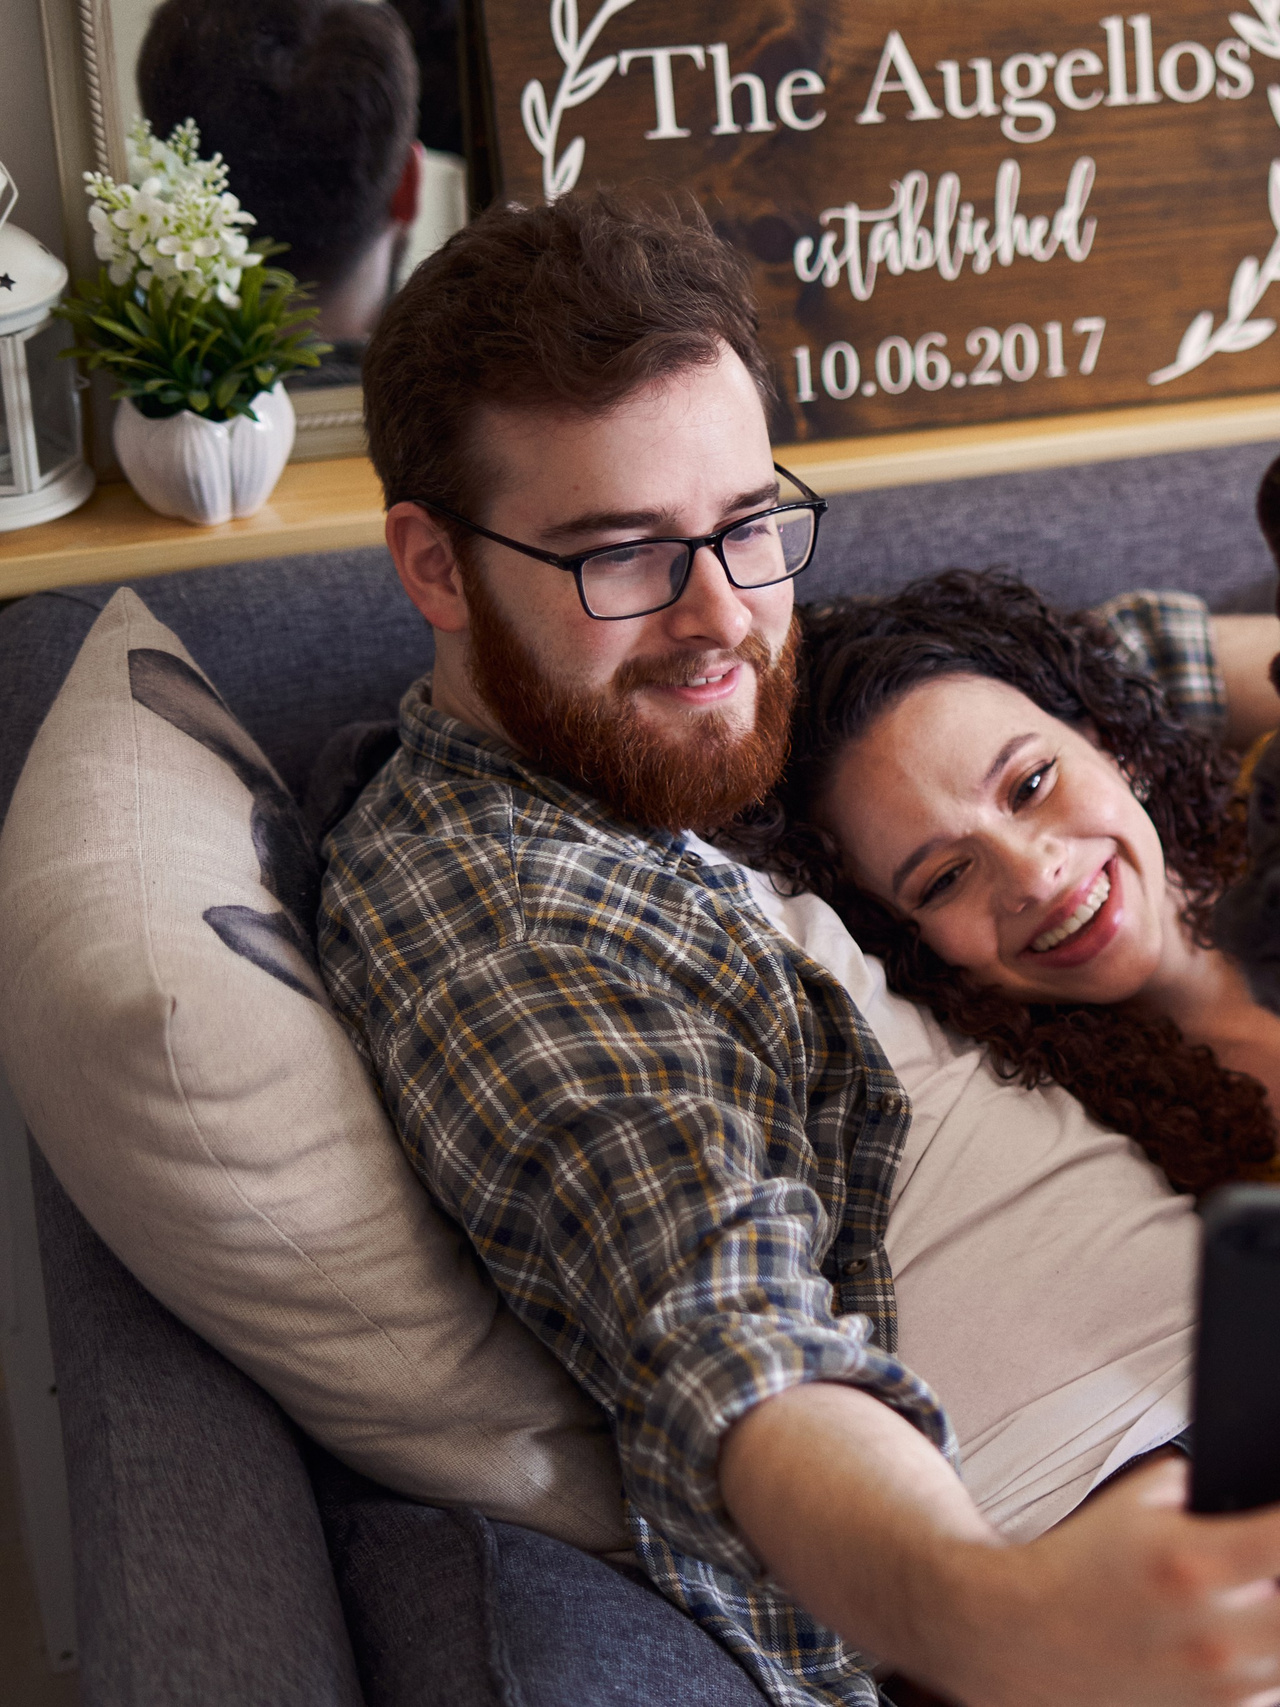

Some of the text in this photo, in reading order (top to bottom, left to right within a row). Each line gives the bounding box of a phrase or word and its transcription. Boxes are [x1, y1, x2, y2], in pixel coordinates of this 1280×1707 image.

[618, 13, 1255, 144] The Augellos
[793, 155, 1098, 302] established
[792, 316, 1107, 403] 10.06.2017
